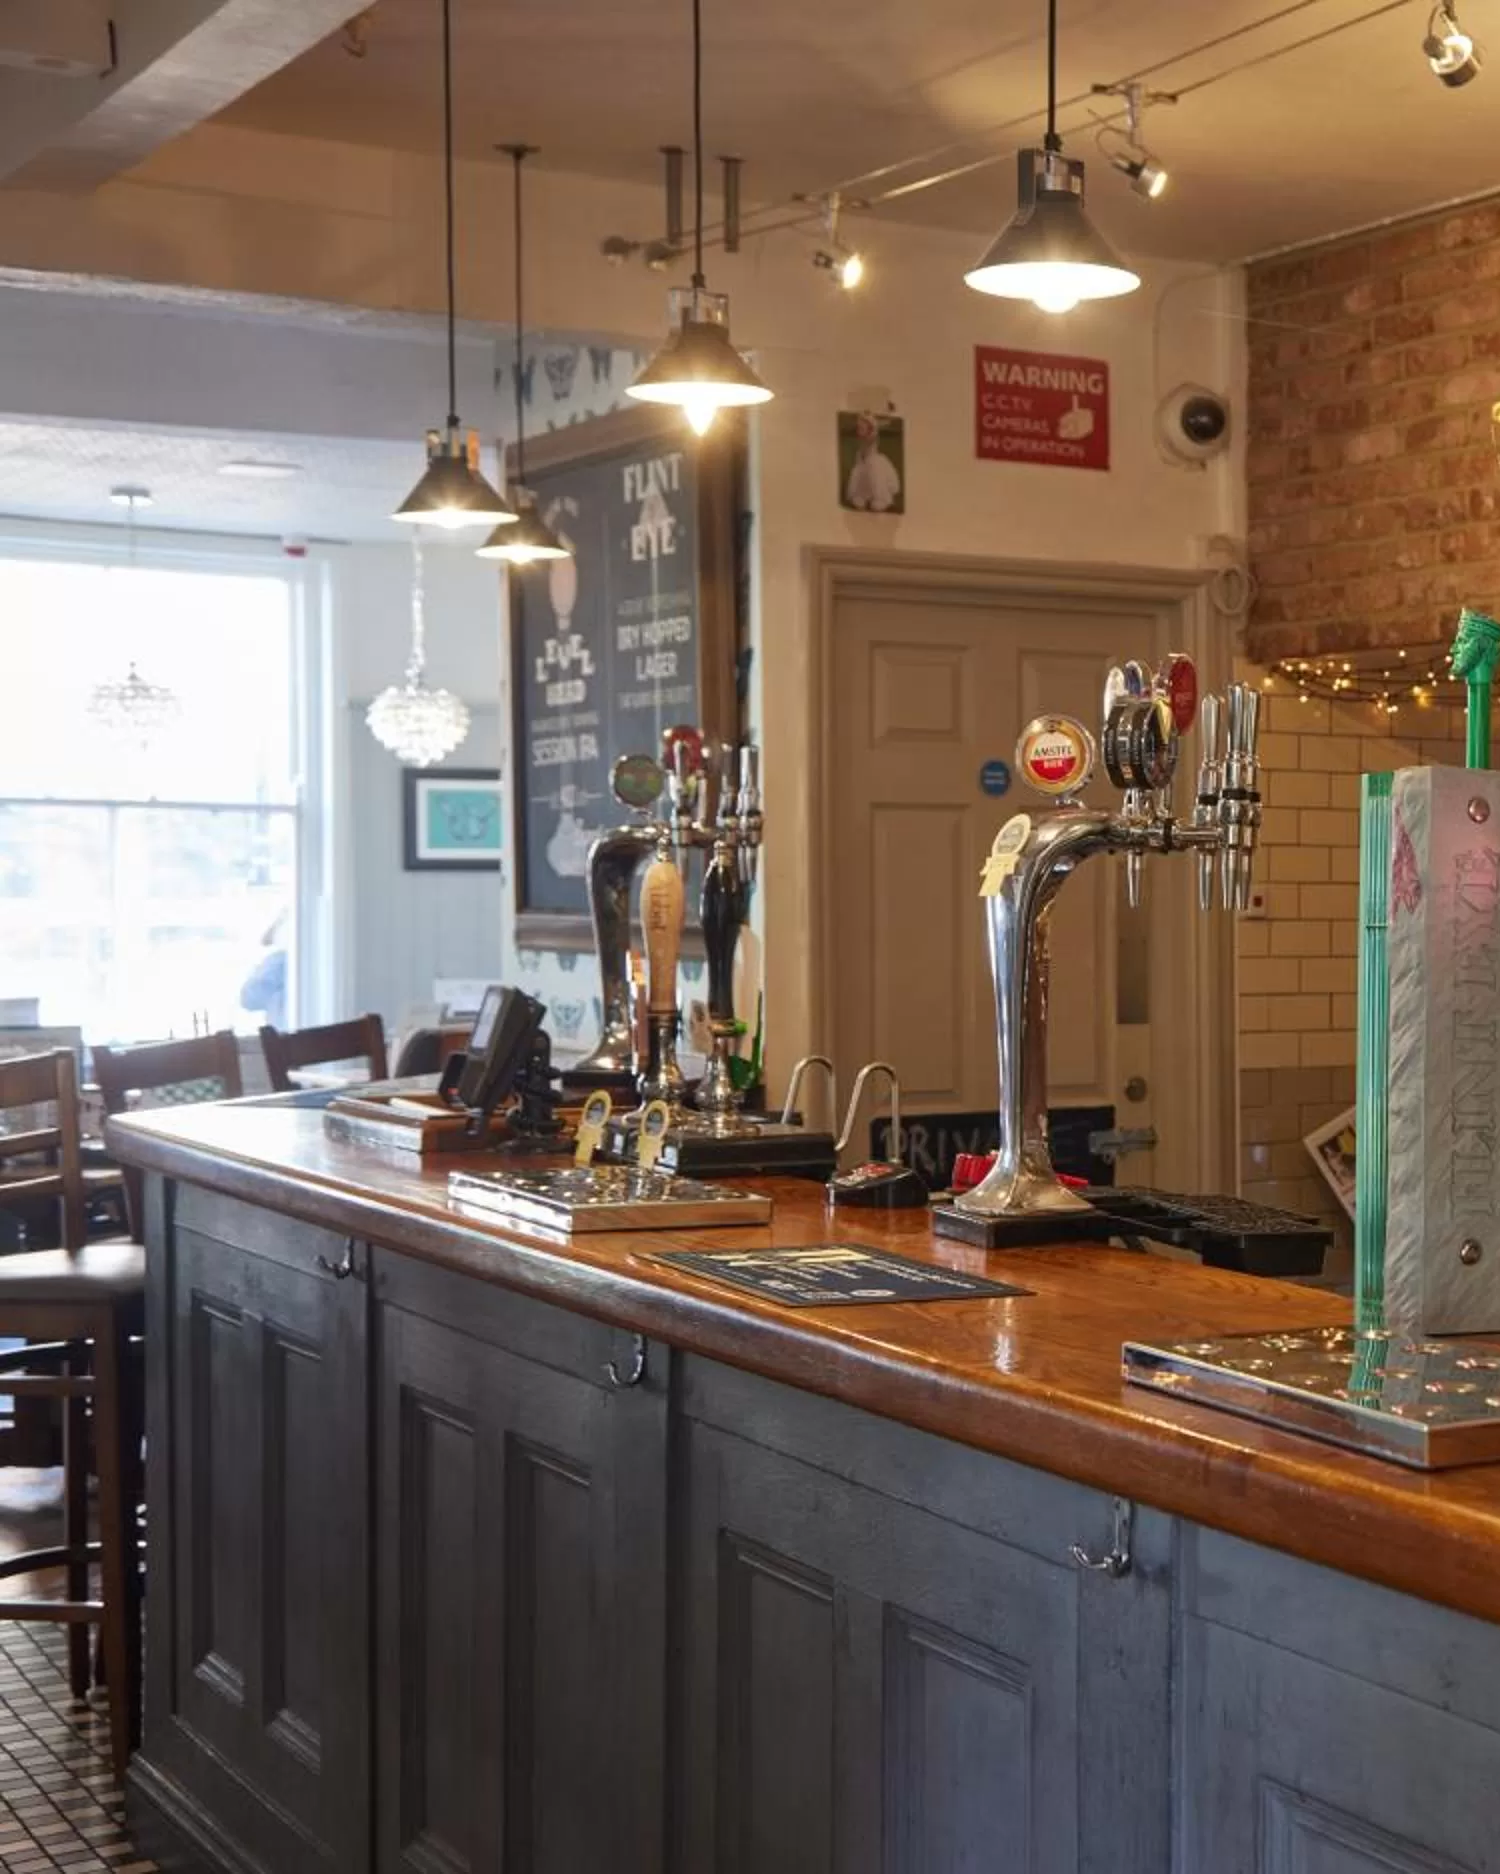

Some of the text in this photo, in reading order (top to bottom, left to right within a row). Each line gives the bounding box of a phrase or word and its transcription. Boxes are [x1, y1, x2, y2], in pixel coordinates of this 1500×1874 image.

[982, 361, 1104, 396] WARNING
[623, 452, 683, 503] FLINT
[630, 514, 677, 562] EYE
